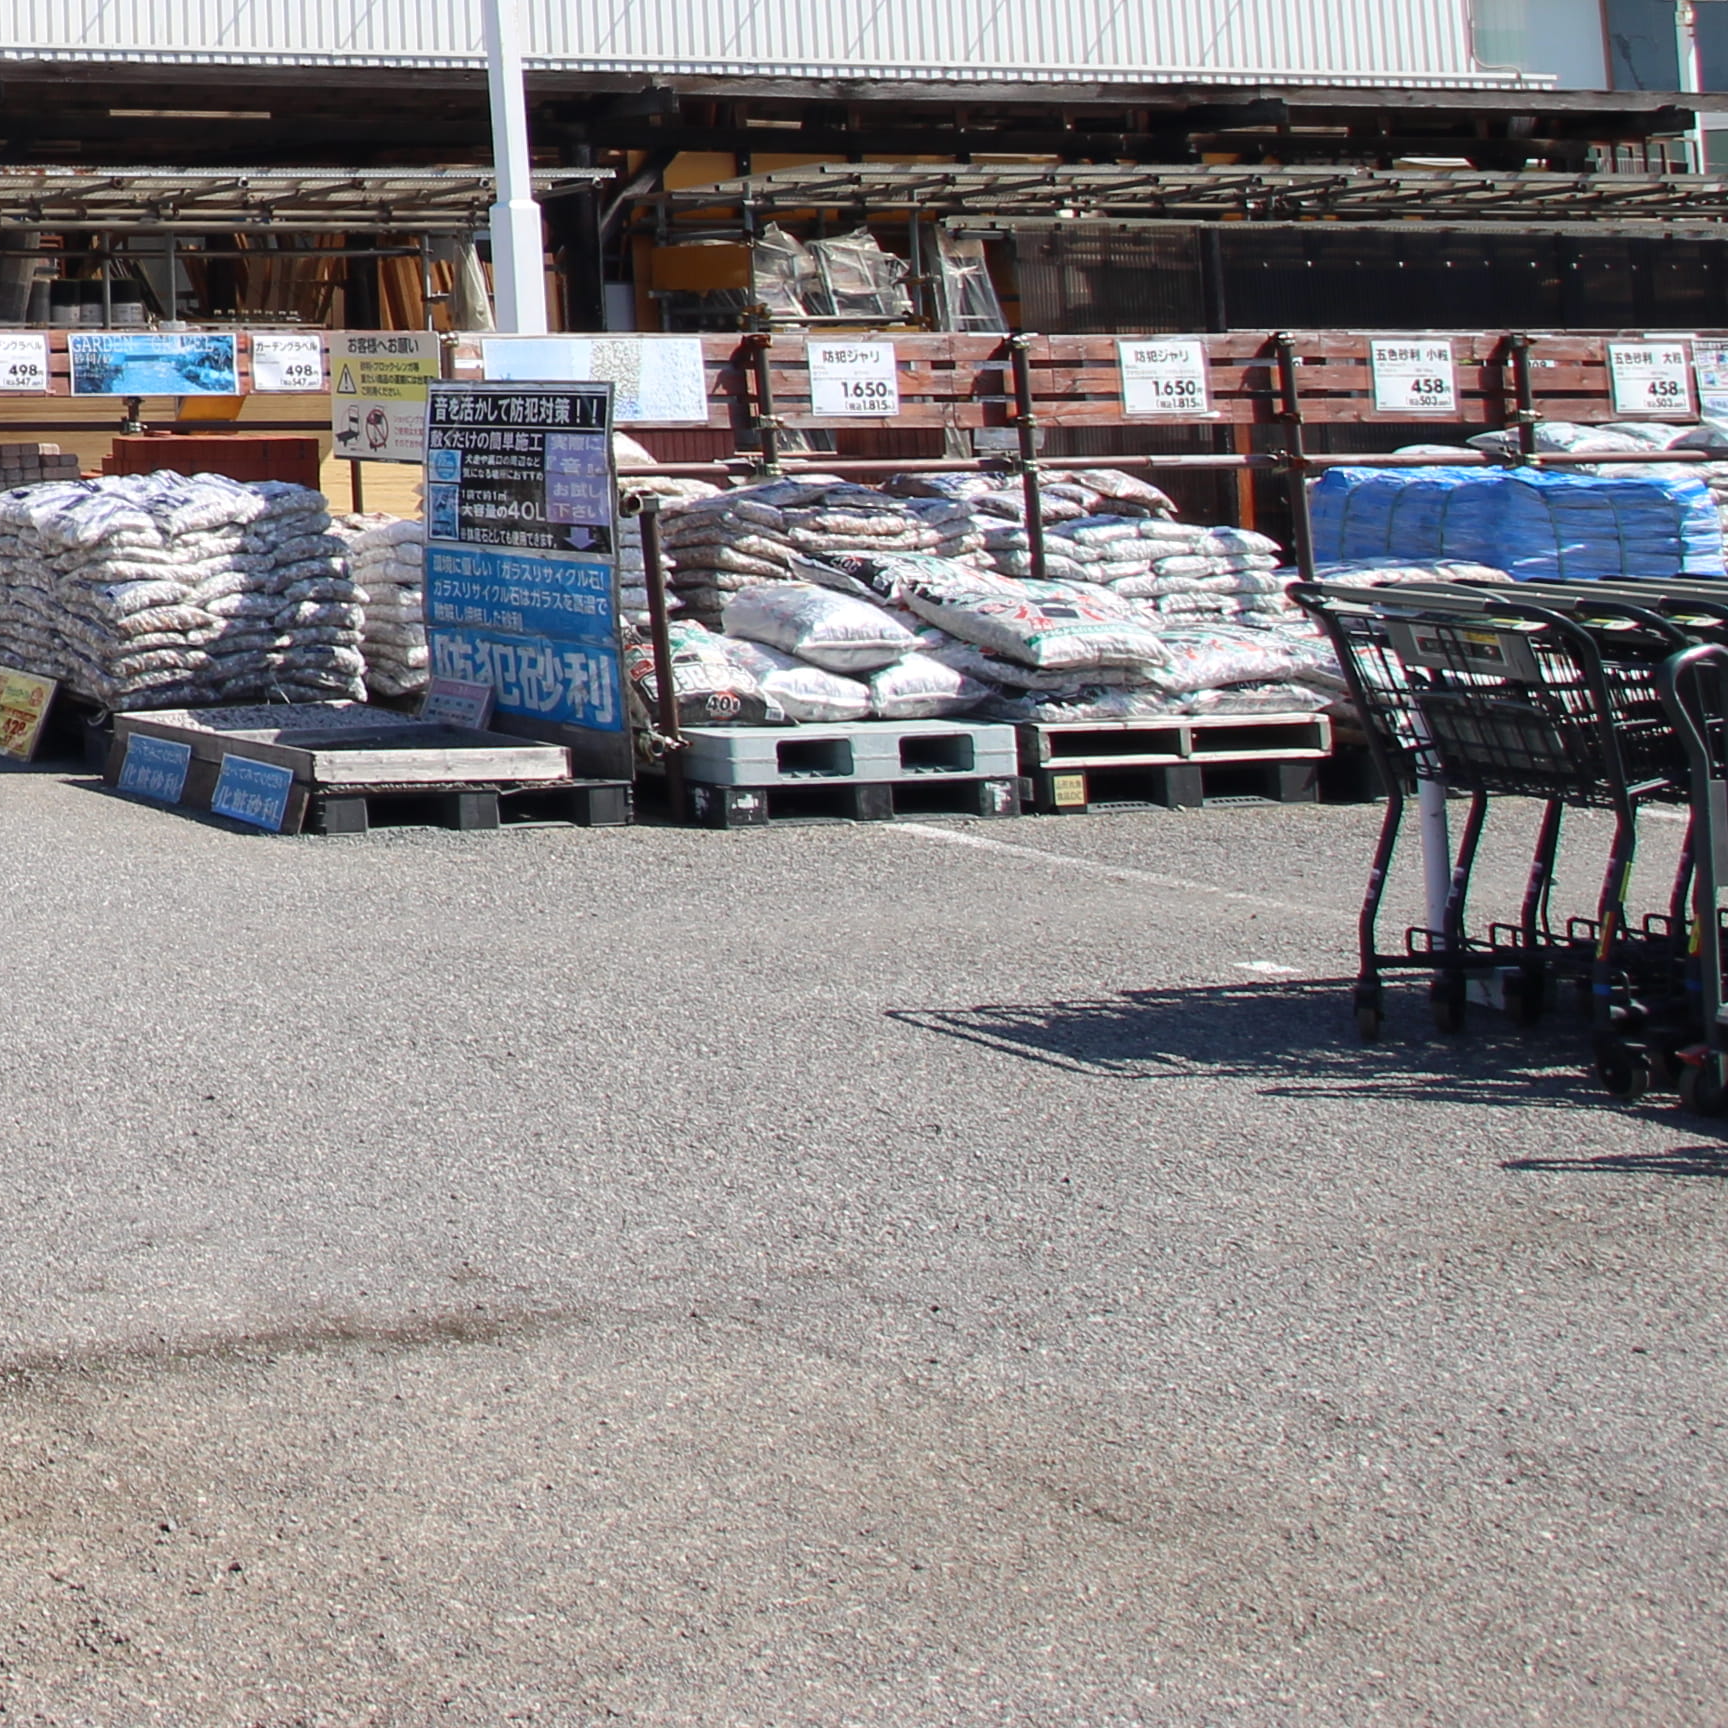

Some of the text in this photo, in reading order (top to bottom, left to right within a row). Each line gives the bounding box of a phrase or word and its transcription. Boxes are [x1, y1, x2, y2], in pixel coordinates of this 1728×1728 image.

[255, 341, 318, 352] ガーデングラベル
[348, 338, 419, 353] お客様へお願い
[822, 350, 880, 363] 防犯ジャリ
[1134, 350, 1189, 363] 防犯ジャリ
[1375, 349, 1421, 362] 五色砂利
[430, 431, 543, 451] 敷くだけの簡単施工
[550, 435, 603, 451] 実際に
[552, 483, 602, 498] お試し
[461, 500, 546, 521] 大容量の40L
[553, 503, 604, 519] 下さい
[434, 633, 613, 723] 防犯砂利
[123, 763, 180, 796] 化粧砂利
[216, 785, 279, 820] 化粧砂利
